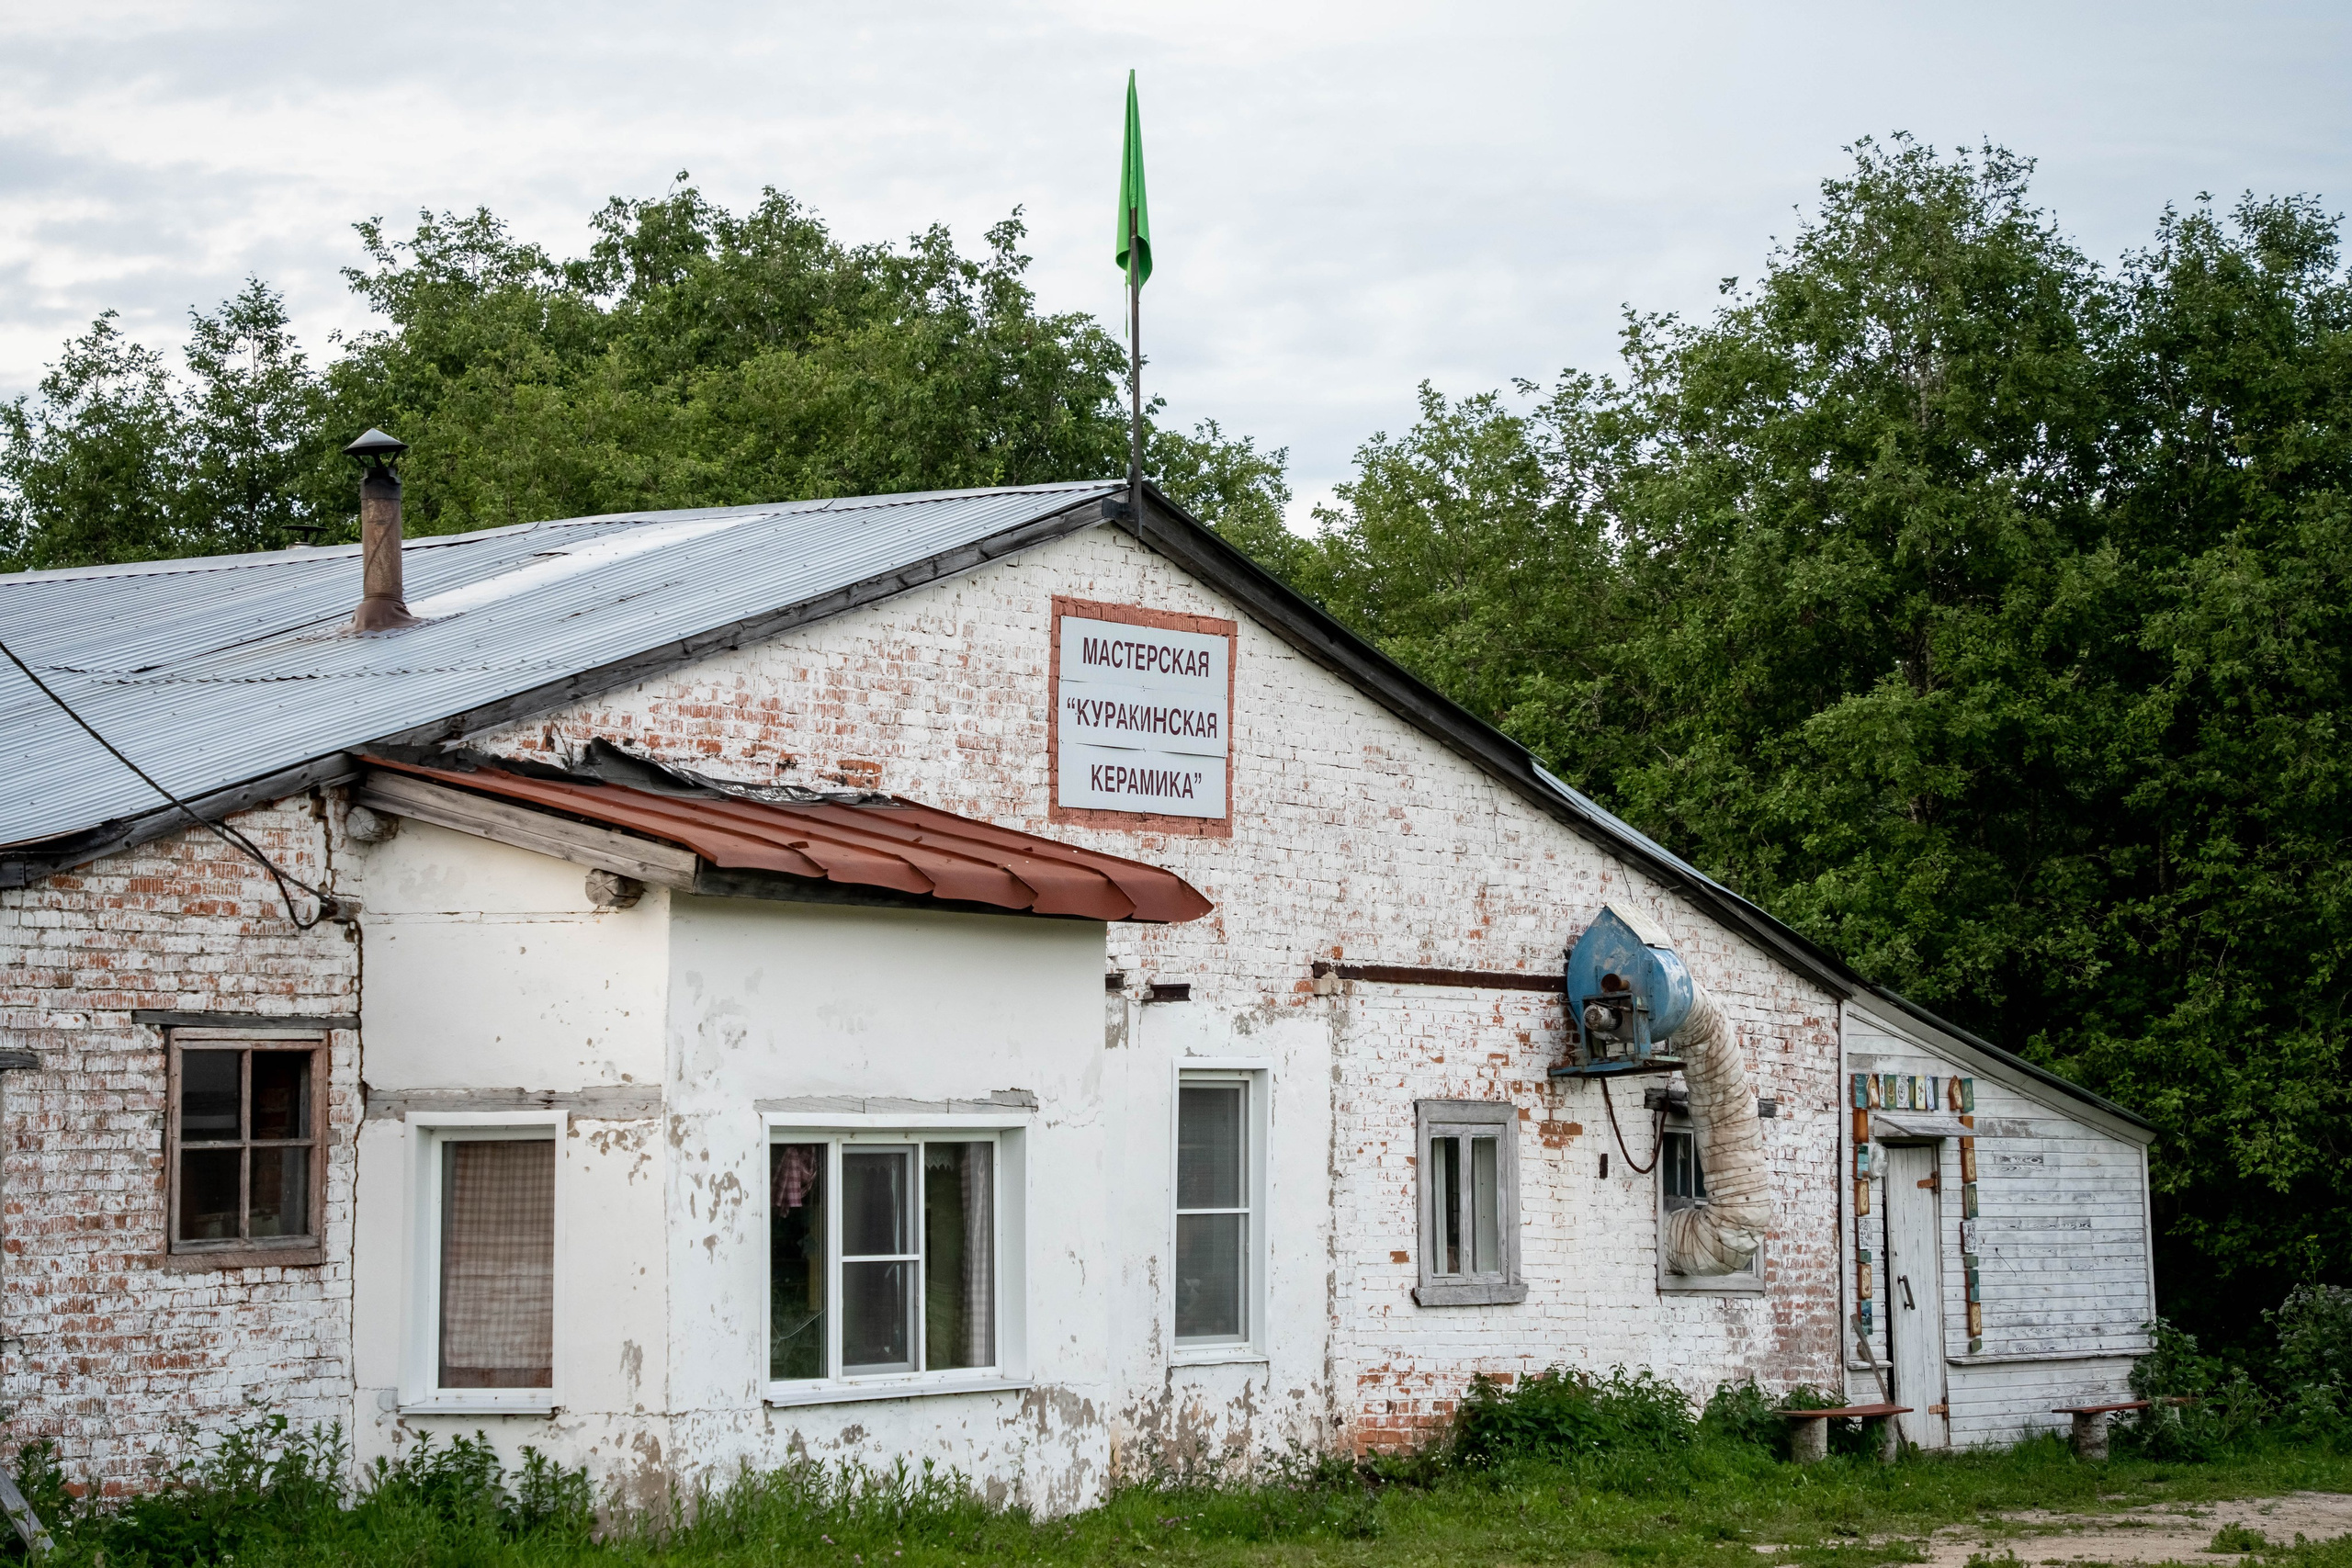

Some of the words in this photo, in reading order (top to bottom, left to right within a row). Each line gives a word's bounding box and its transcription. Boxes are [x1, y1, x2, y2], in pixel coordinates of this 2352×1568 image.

[1082, 637, 1209, 678] МАСТЕРСКАЯ
[1066, 696, 1217, 739] “КУРАКИНСКАЯ
[1091, 762, 1202, 799] КЕРАМИКА”
